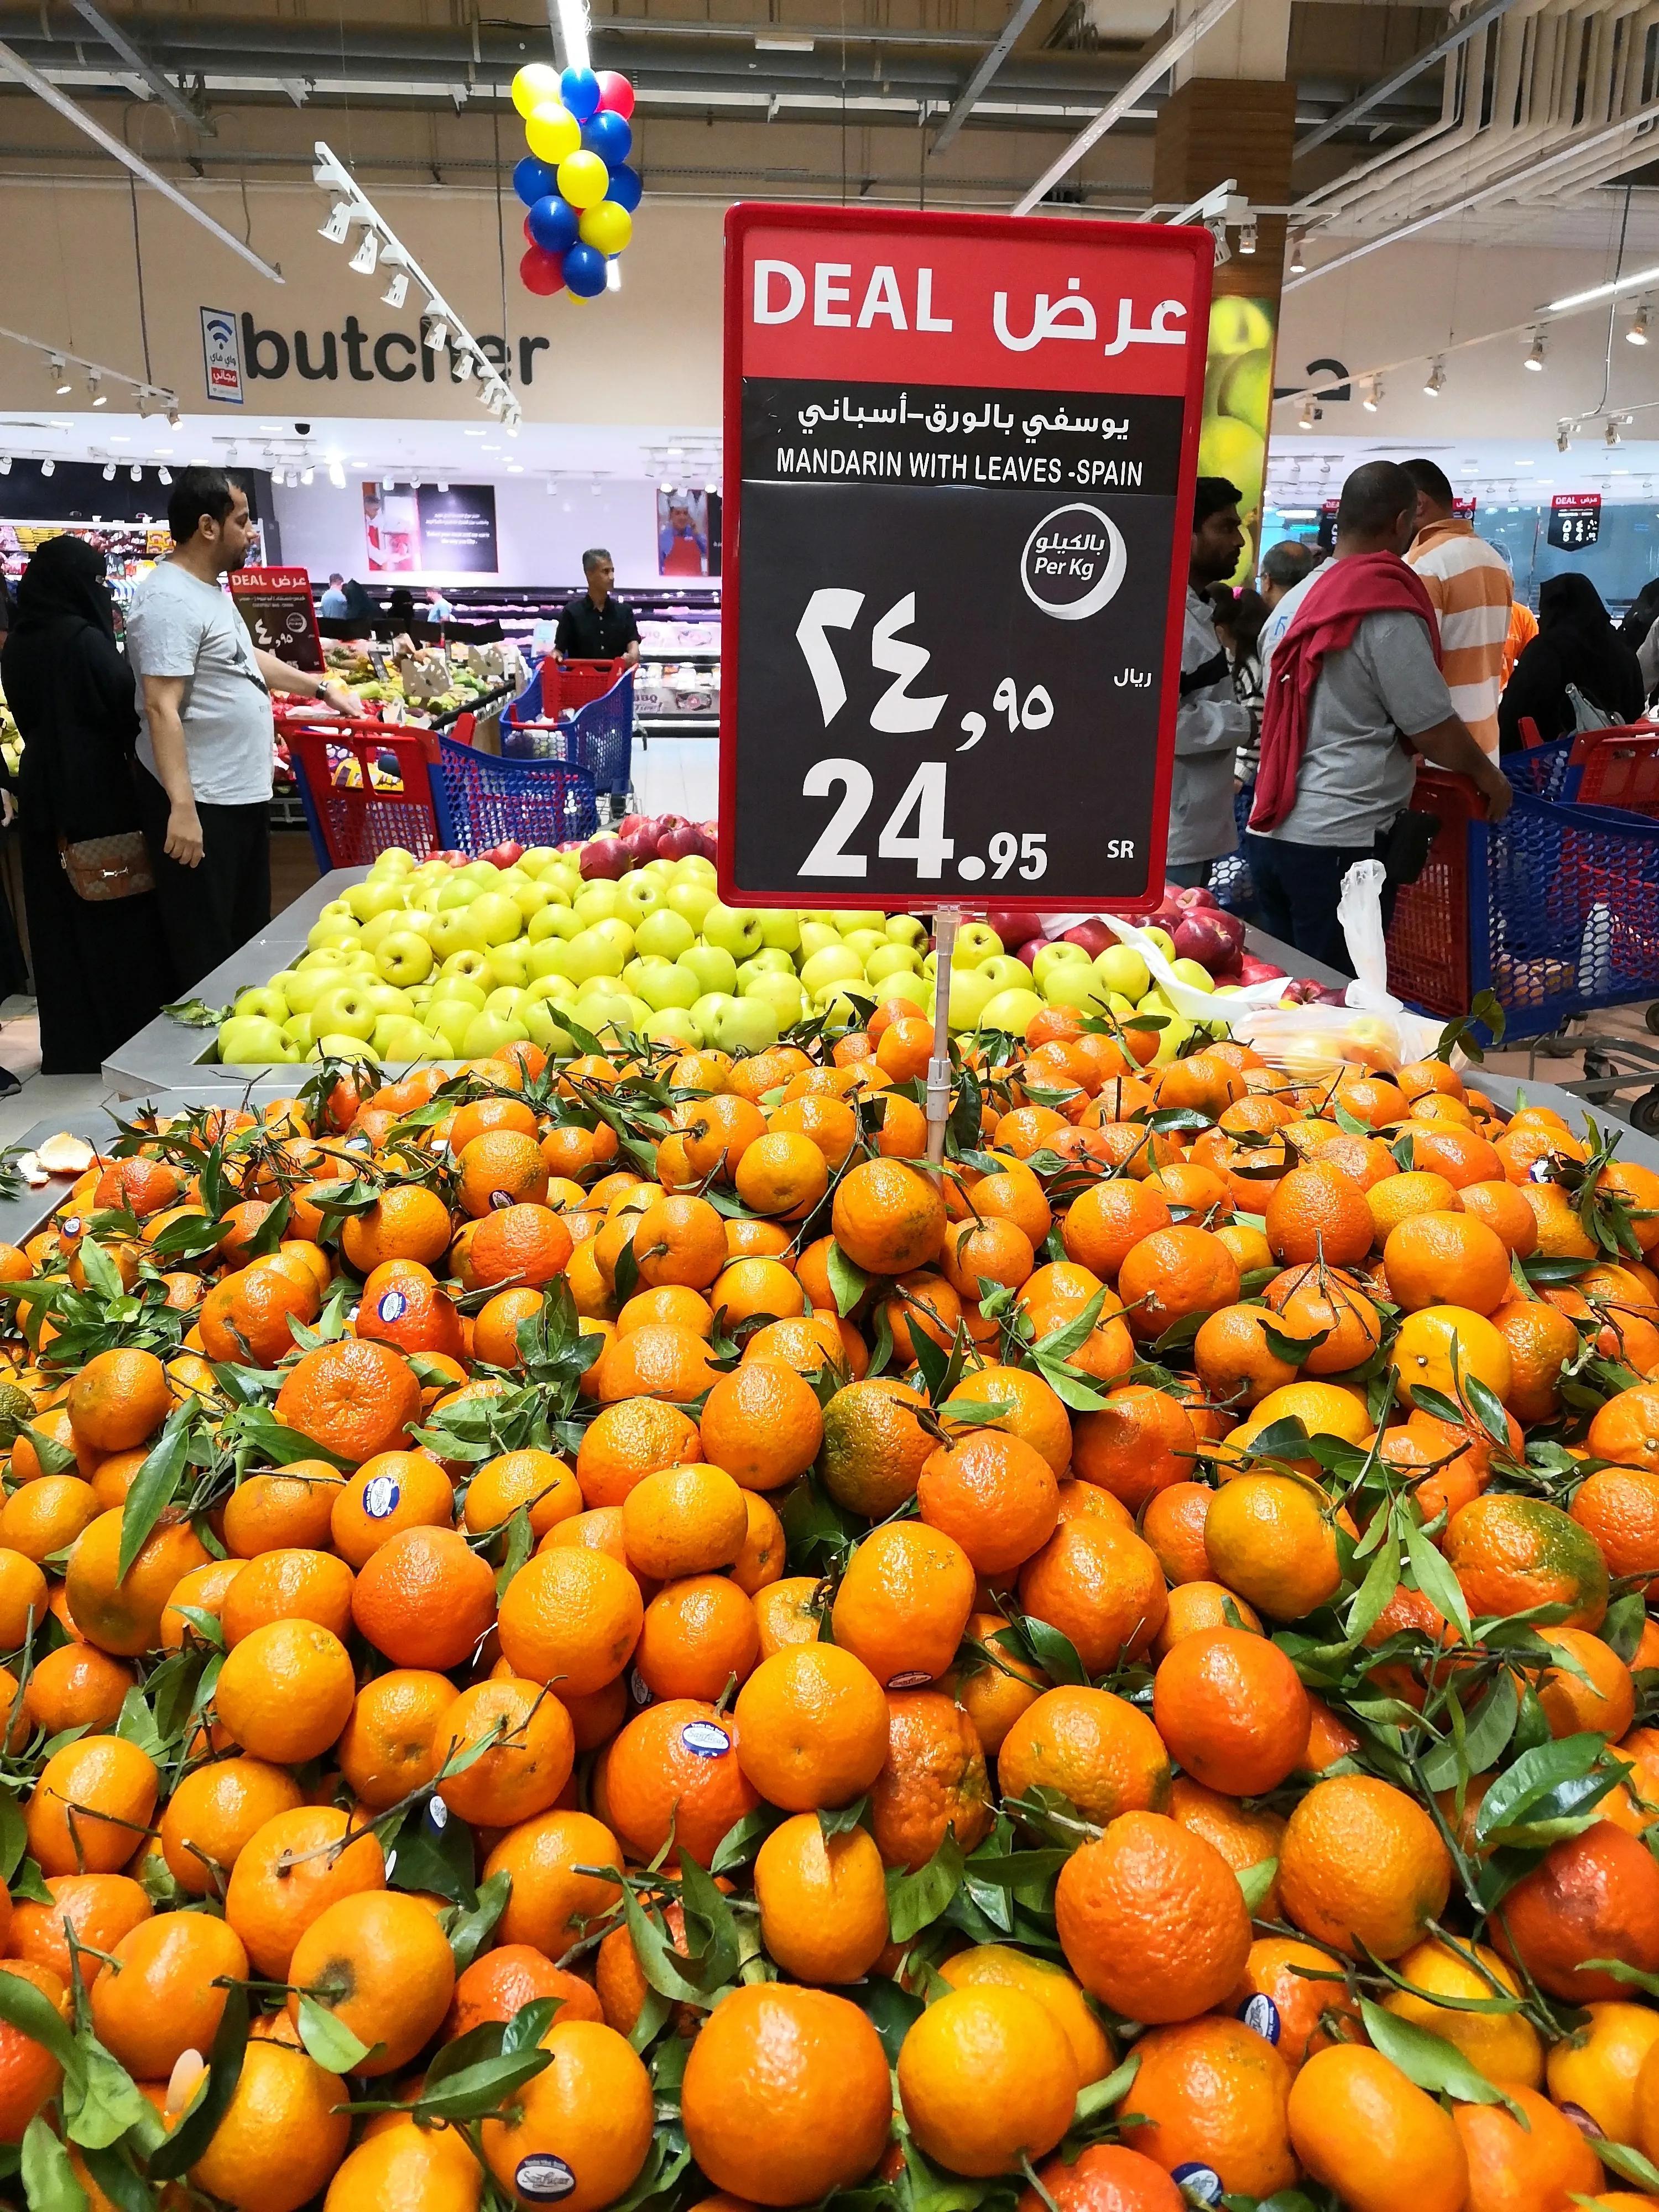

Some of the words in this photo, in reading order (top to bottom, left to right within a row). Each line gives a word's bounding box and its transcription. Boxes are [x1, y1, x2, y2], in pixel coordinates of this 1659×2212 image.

[754, 260, 952, 332] DEAL
[994, 278, 1187, 356] عرض
[241, 312, 550, 385] butcher
[213, 369, 237, 384] مجاني
[1025, 408, 1129, 443] يوسفي
[778, 448, 901, 476] MANDARIN
[910, 452, 967, 479] WITH
[975, 455, 1062, 483] LEAVES
[1556, 497, 1577, 505] DEAL
[1035, 533, 1105, 555] بالكيلو
[1035, 557, 1066, 574] Per
[1069, 559, 1094, 580] Kg
[232, 575, 267, 586] DEAL
[272, 575, 306, 588] عرض
[1114, 669, 1151, 687] ريال
[797, 759, 1047, 880] 24.95
[1108, 840, 1134, 858] SR
